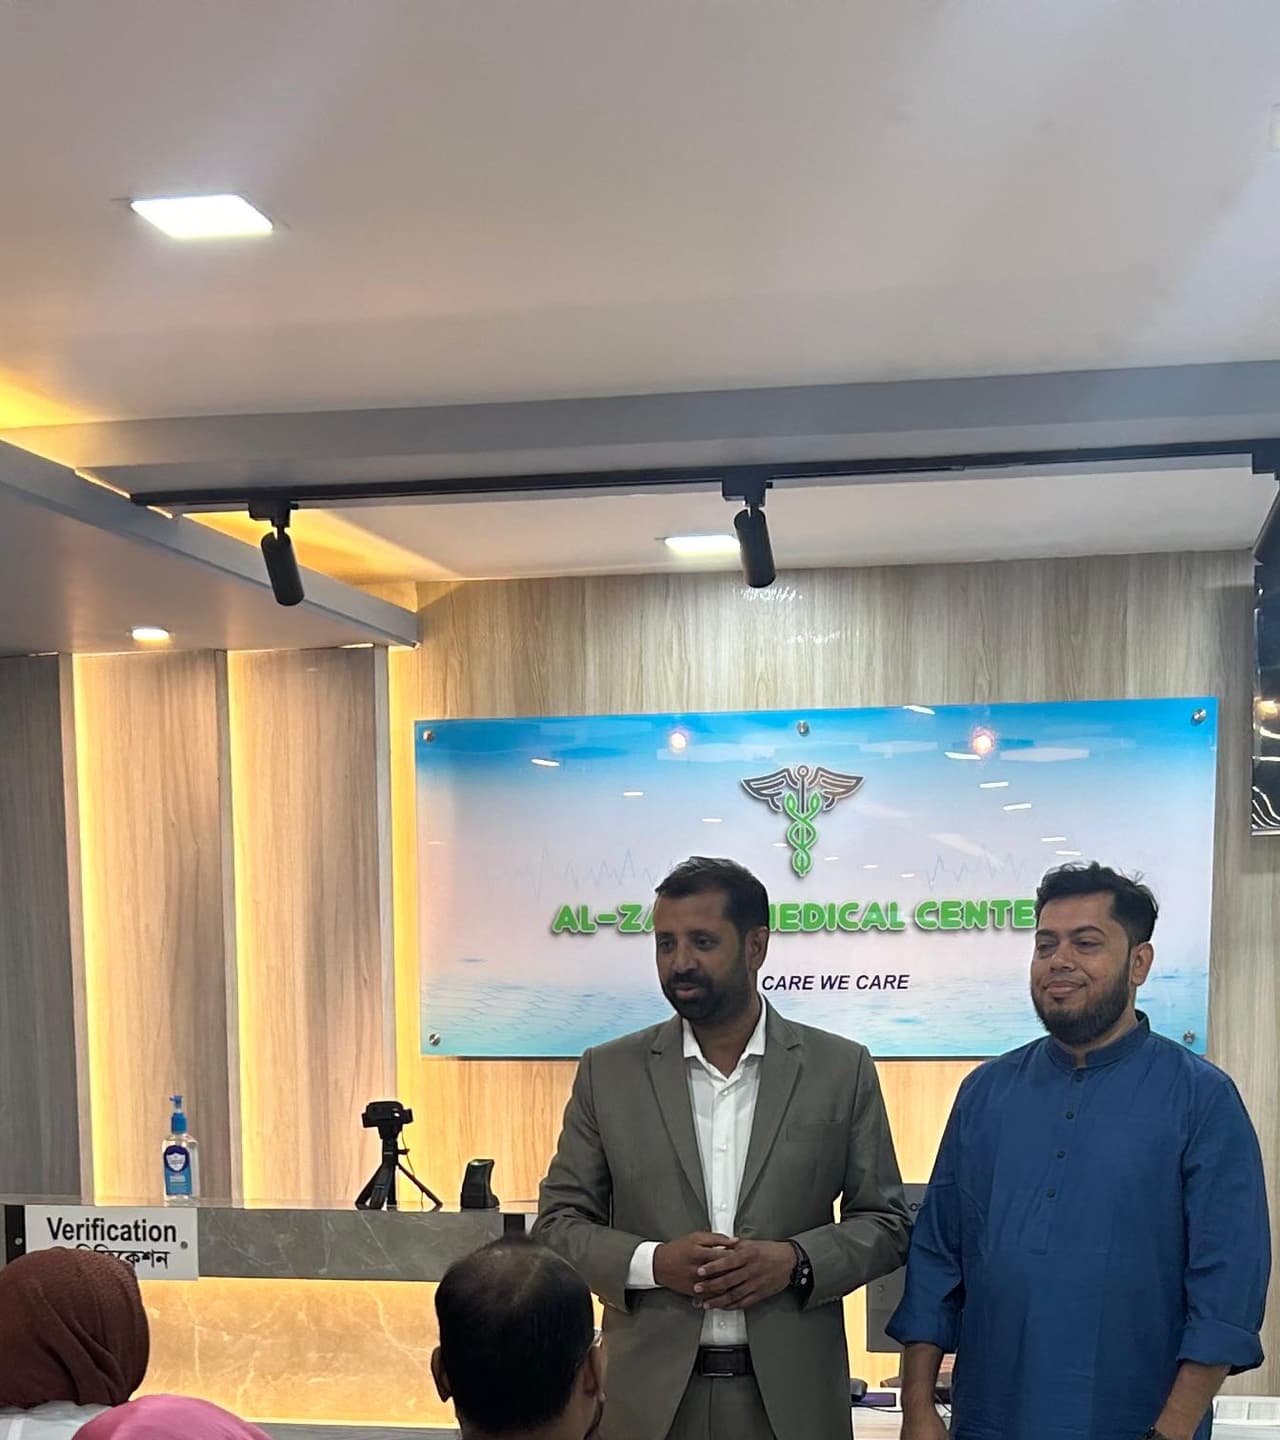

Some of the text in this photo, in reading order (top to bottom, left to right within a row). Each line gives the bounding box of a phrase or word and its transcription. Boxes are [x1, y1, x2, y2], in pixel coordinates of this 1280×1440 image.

[914, 899, 1038, 930] CENTE
[762, 974, 911, 991] CARE WE CARE
[46, 1216, 177, 1243] Verification
